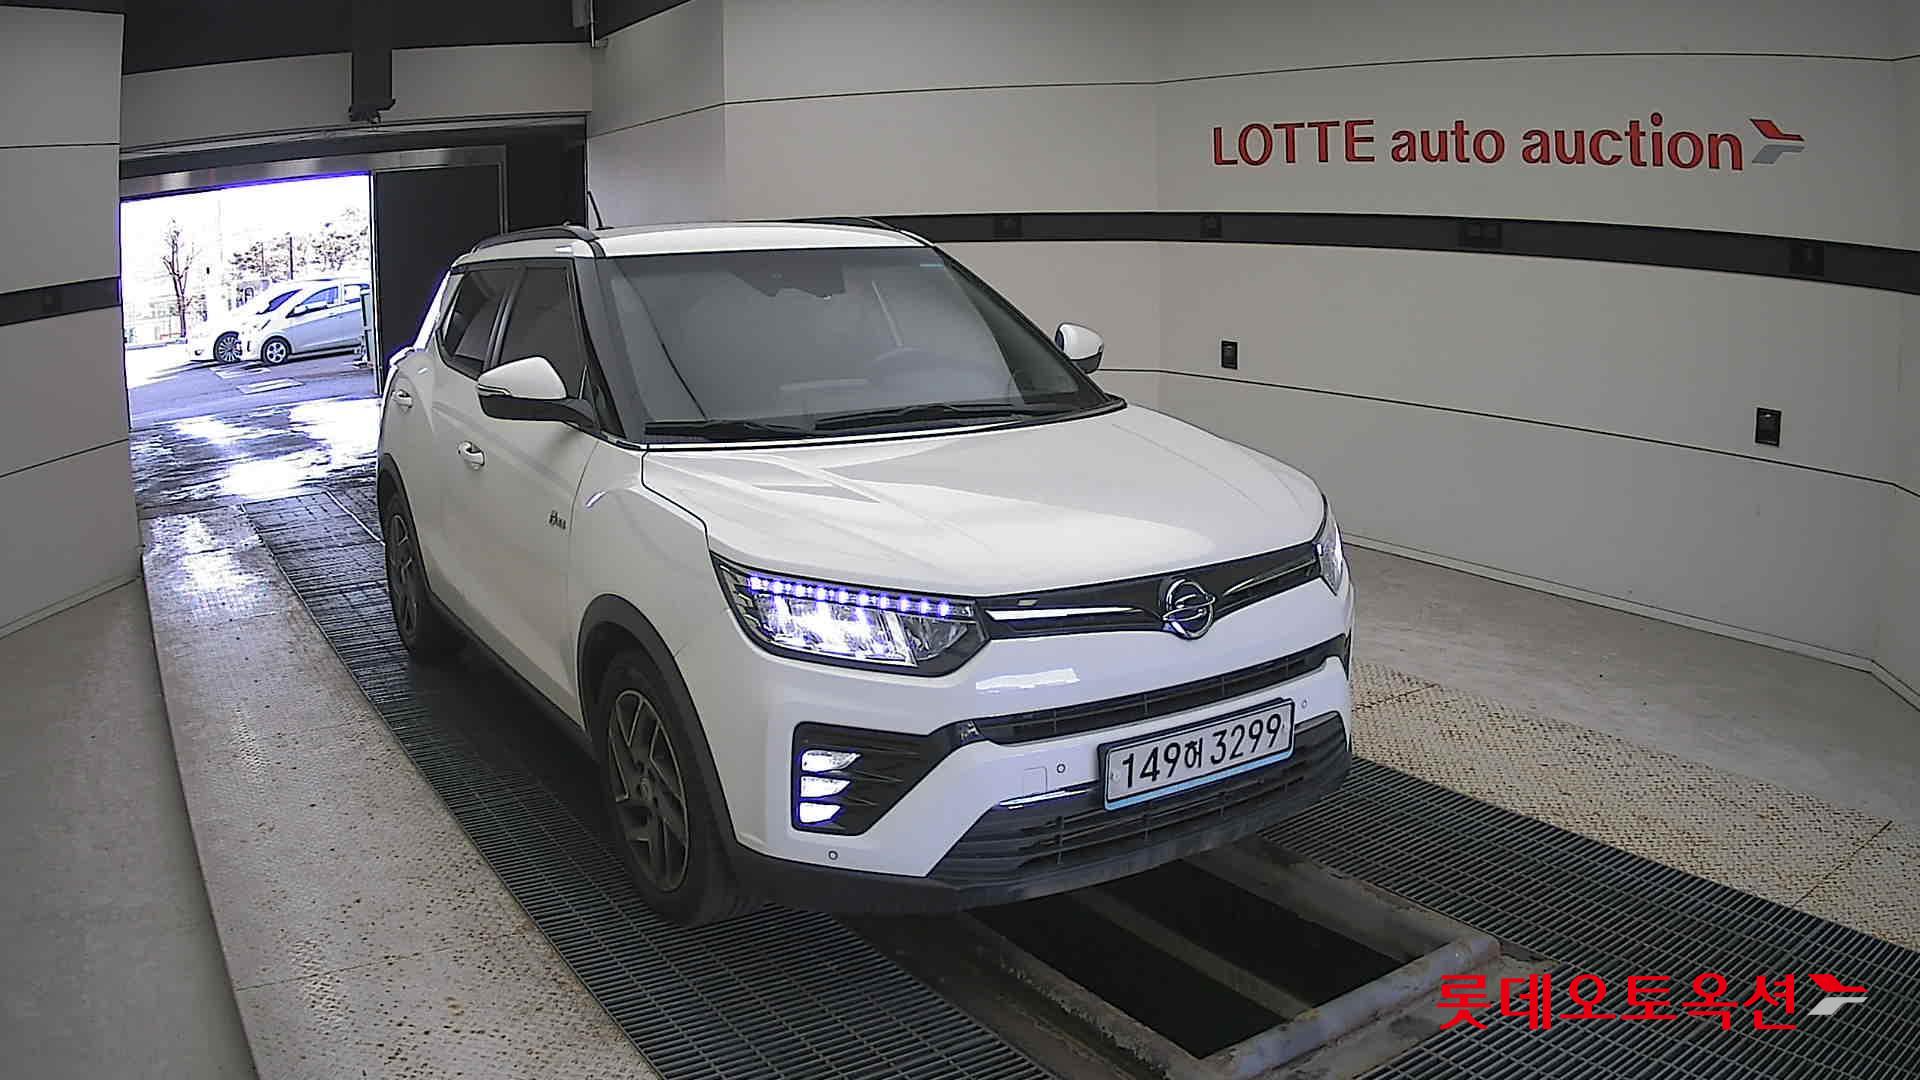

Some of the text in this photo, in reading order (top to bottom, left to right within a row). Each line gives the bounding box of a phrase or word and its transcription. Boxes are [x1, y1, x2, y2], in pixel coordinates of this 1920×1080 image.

[1212, 112, 1743, 171] LOTTE auto auction
[1122, 713, 1282, 788] 149허 3299
